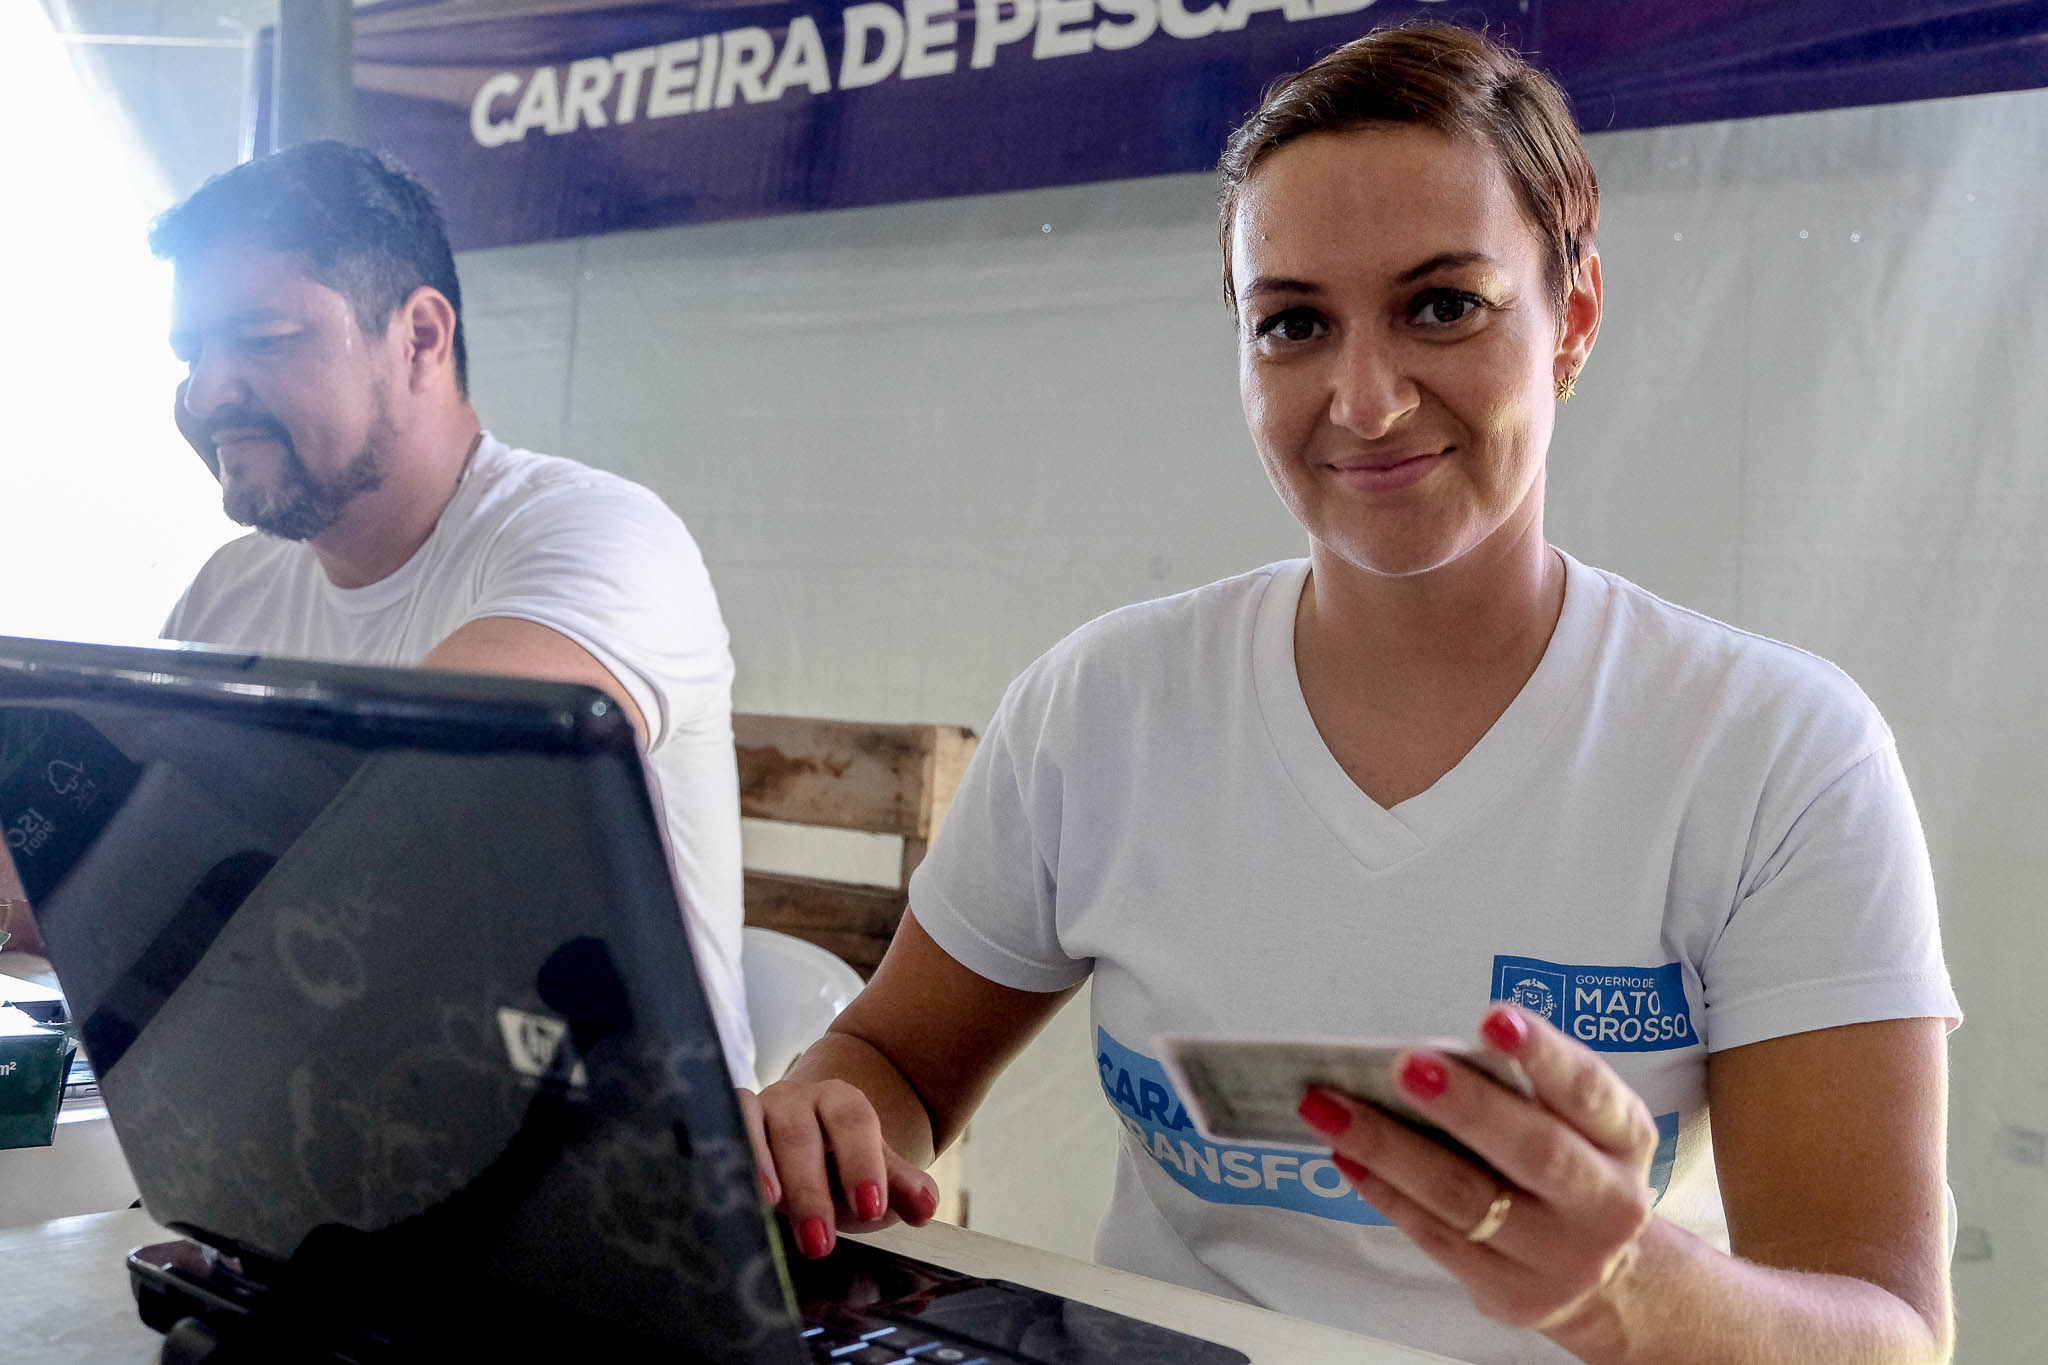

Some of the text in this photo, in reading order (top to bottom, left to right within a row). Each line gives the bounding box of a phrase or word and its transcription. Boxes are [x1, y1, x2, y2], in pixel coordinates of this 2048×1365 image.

[470, 17, 830, 147] CARTEIRA
[839, 0, 957, 89] DE
[1575, 975, 1655, 988] GOVERNO DE
[1575, 987, 1661, 1015] MATO
[1573, 1013, 1688, 1042] GROSSO
[1114, 1110, 1360, 1199] RANSFO
